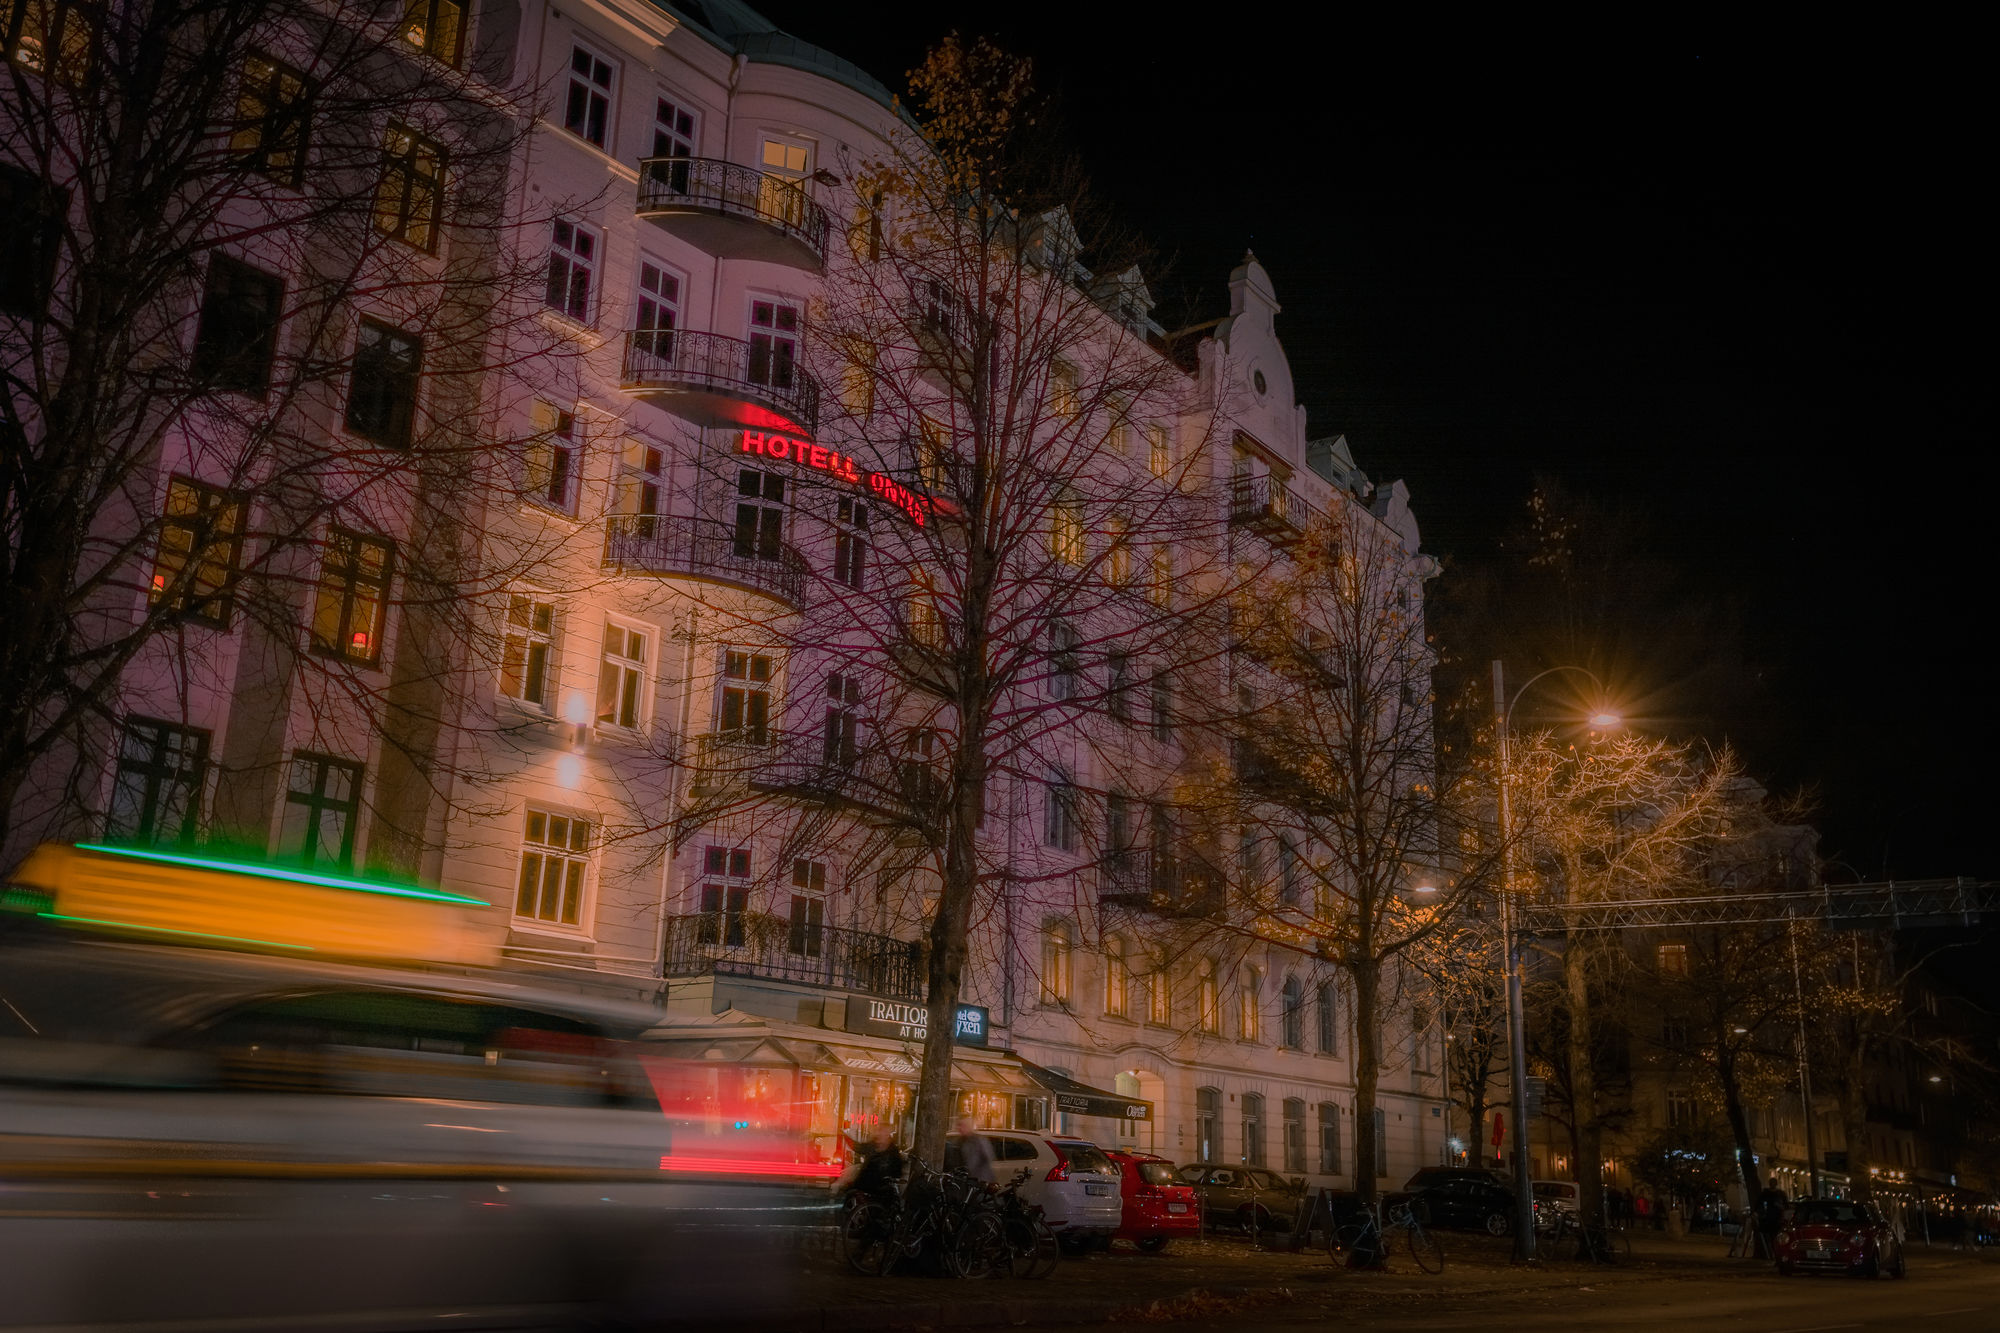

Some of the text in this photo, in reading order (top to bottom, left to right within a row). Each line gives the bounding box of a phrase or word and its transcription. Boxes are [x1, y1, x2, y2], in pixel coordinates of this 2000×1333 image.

[742, 430, 859, 482] HOTELL
[869, 1000, 928, 1025] TRATTOR
[899, 1026, 927, 1039] AT HO
[955, 1020, 981, 1038] yxen
